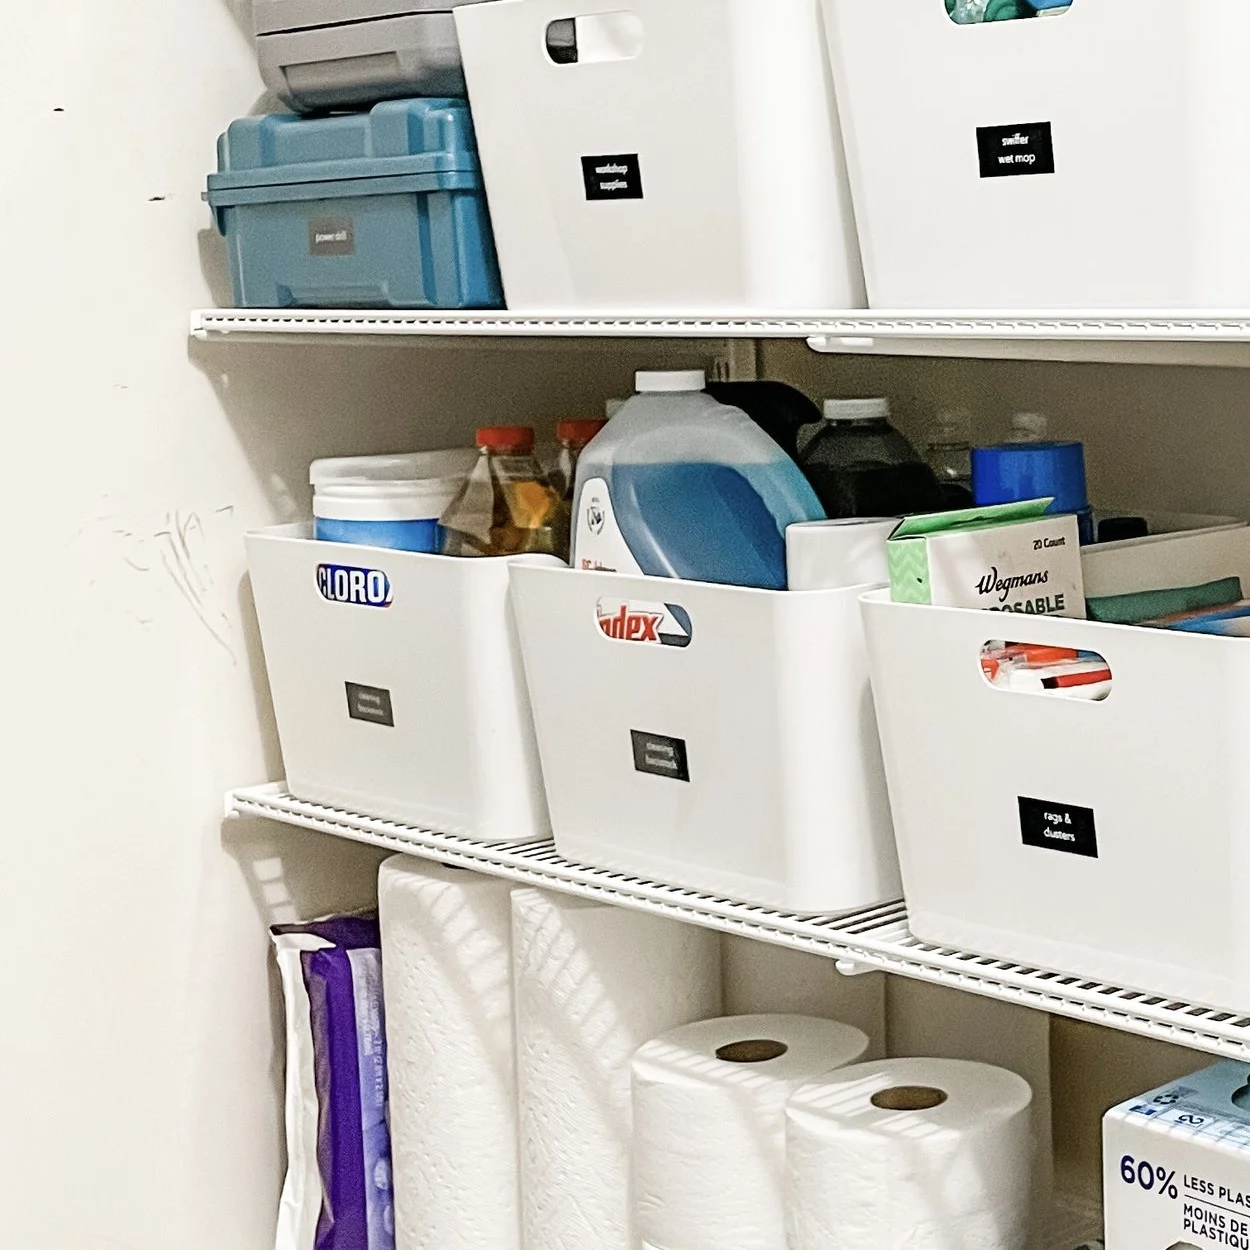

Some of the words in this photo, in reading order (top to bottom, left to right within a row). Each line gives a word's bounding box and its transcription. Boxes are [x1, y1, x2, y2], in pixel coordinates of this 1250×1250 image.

[1002, 133, 1029, 146] swiffer
[998, 154, 1014, 164] wet
[1015, 154, 1036, 165] mop
[1033, 539, 1043, 551] 20
[1044, 536, 1066, 549] Count
[975, 566, 1049, 602] Wegmans
[1043, 812, 1063, 825] rags
[1064, 812, 1072, 824] &
[1043, 826, 1076, 842] dusters
[1120, 1155, 1178, 1200] 60%
[1183, 1174, 1215, 1196] LESS
[1183, 1203, 1226, 1229] MOINS
[1230, 1219, 1249, 1237] DE
